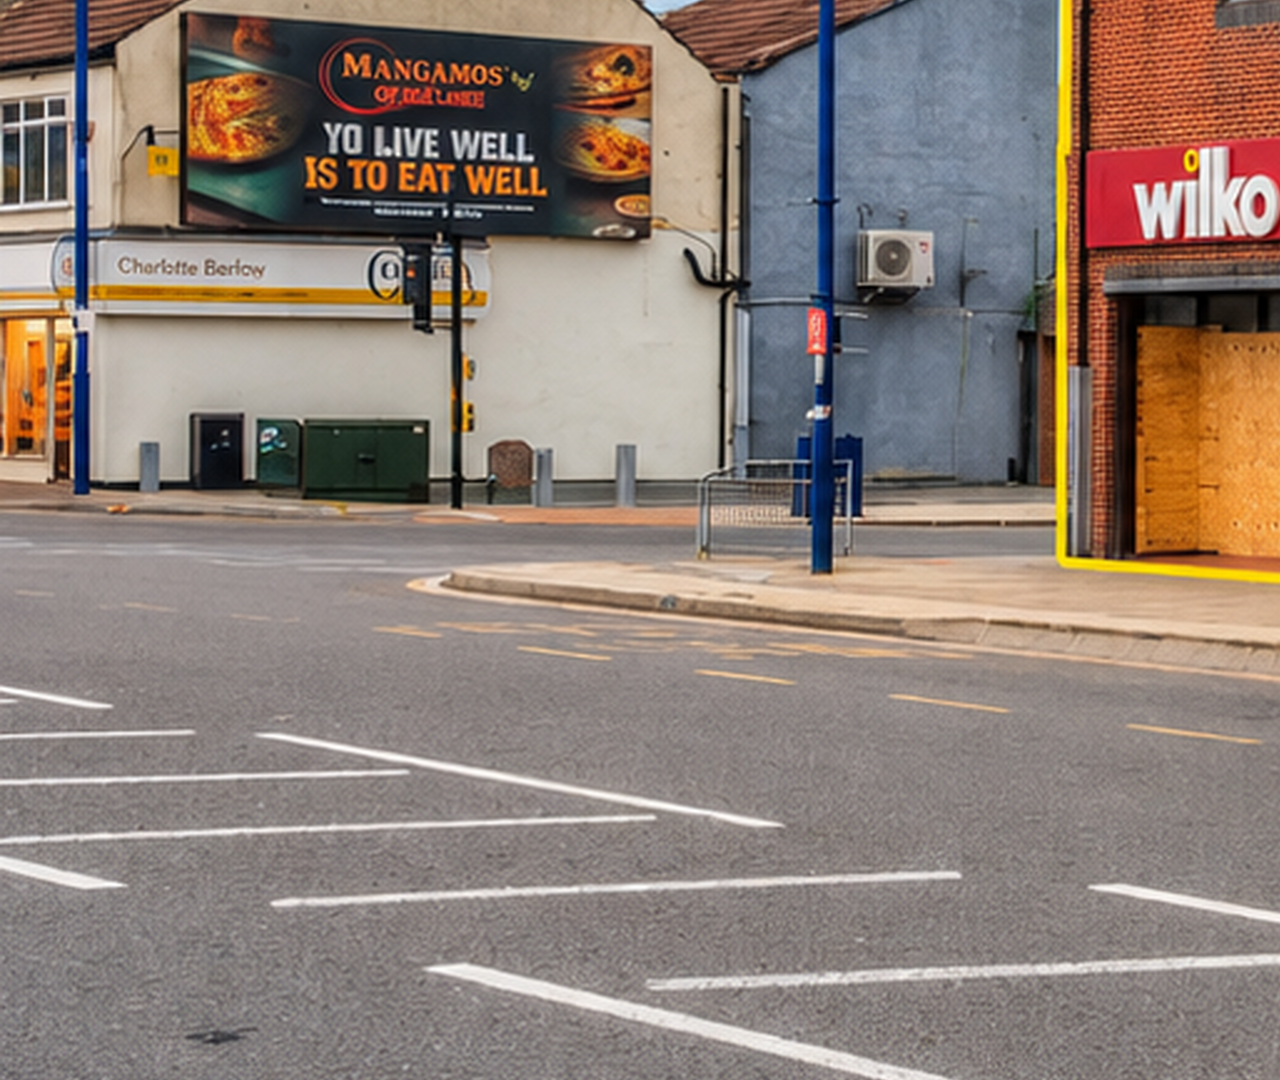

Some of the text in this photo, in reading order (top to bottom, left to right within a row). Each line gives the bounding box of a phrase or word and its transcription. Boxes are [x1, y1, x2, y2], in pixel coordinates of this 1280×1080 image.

[373, 126, 440, 158] LIVE
[451, 129, 535, 162] WELL
[304, 156, 548, 197] IS TO EAT WELL
[1133, 146, 1280, 239] wilko
